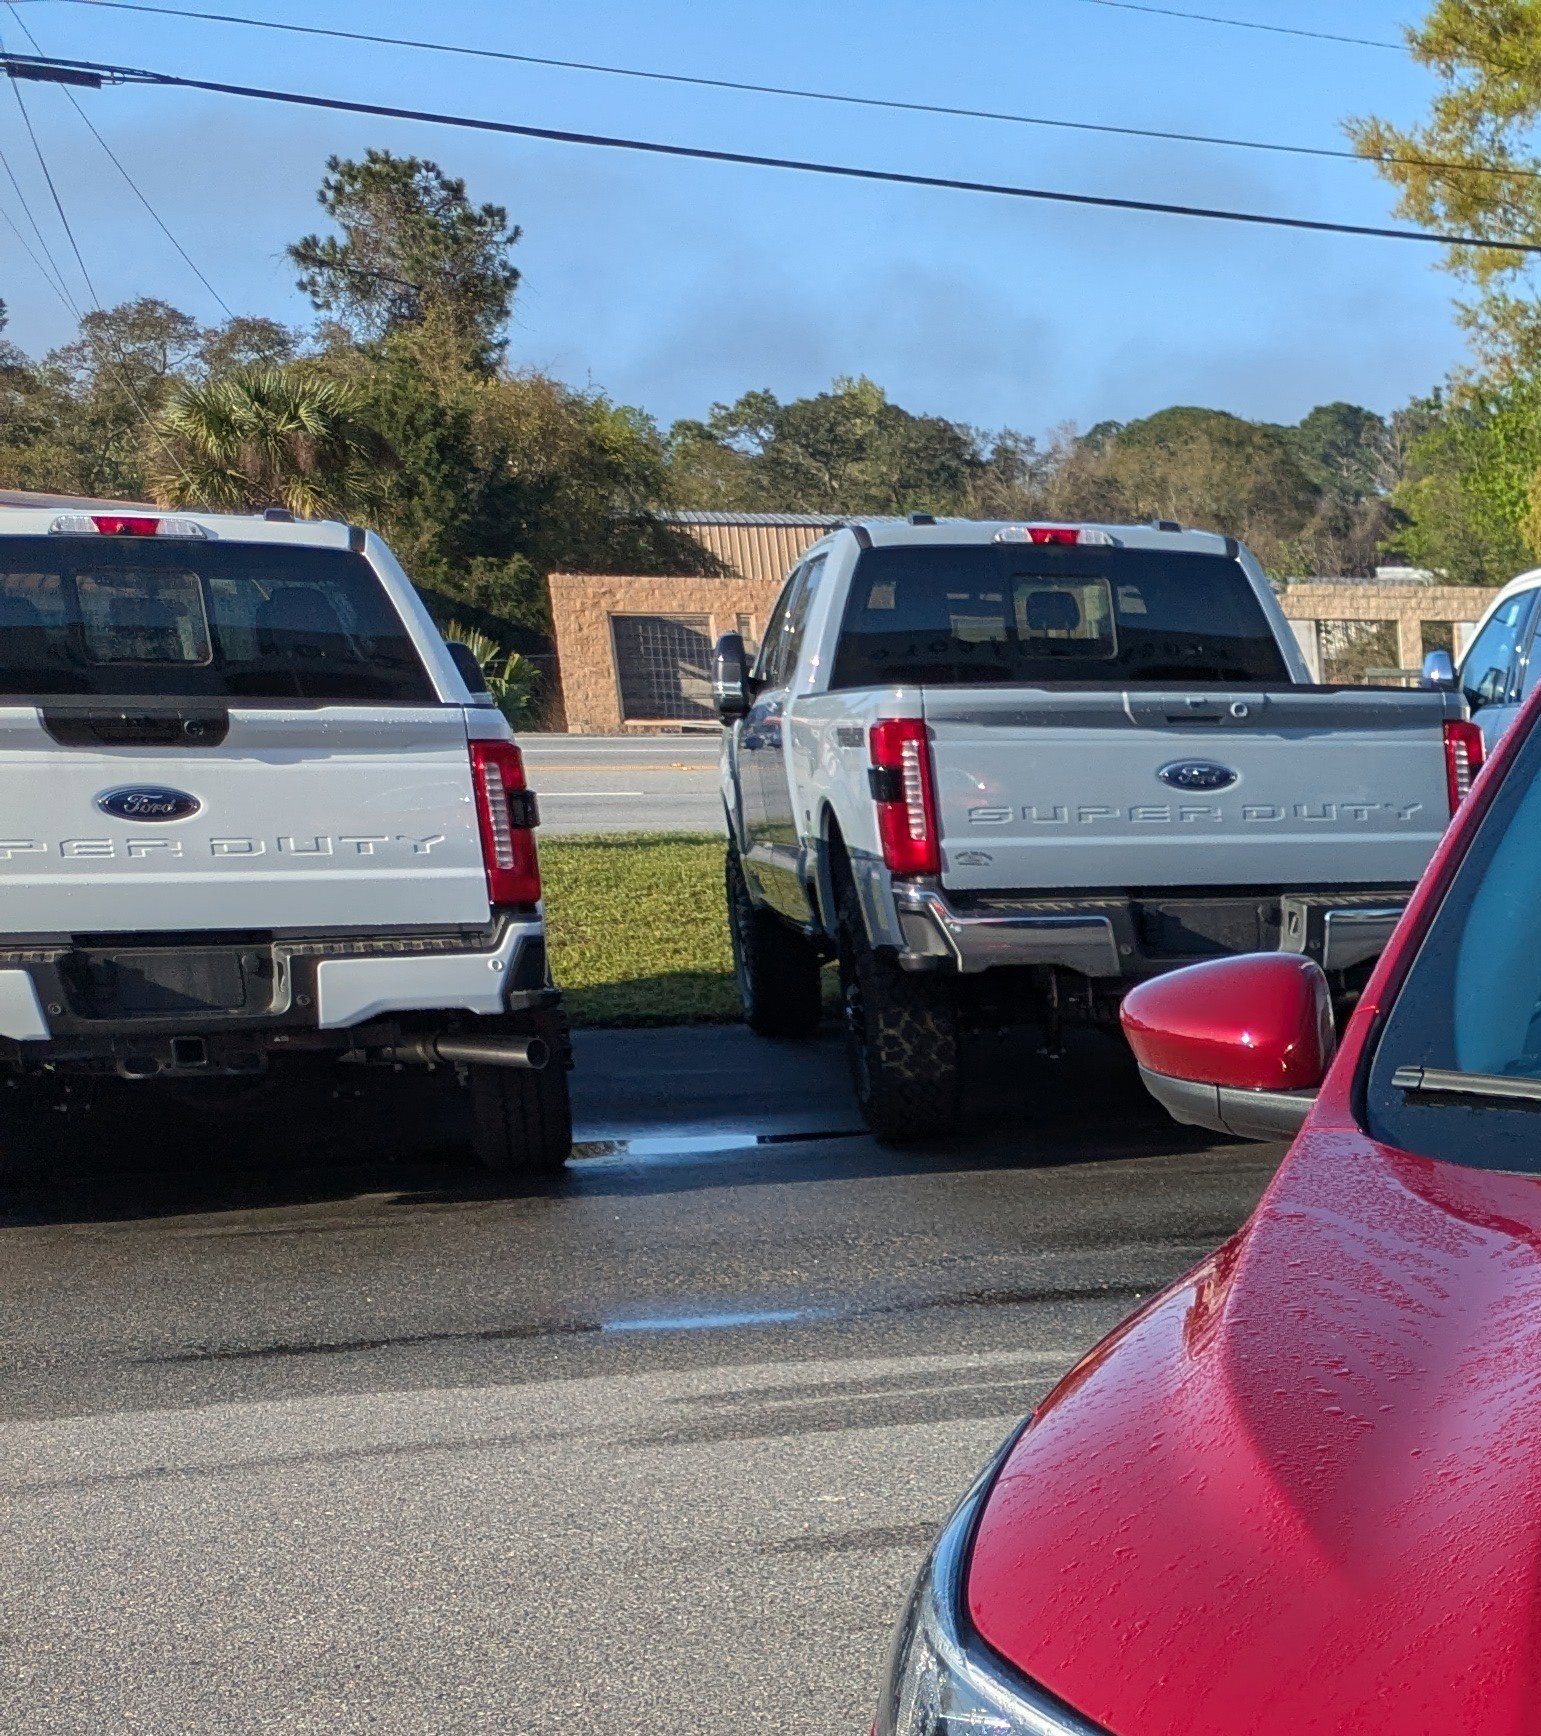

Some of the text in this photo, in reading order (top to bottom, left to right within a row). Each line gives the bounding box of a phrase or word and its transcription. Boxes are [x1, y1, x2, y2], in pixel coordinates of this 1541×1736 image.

[123, 794, 177, 814] Ford
[968, 802, 1425, 825] SUPER DUTY
[209, 835, 446, 858] DUTY
